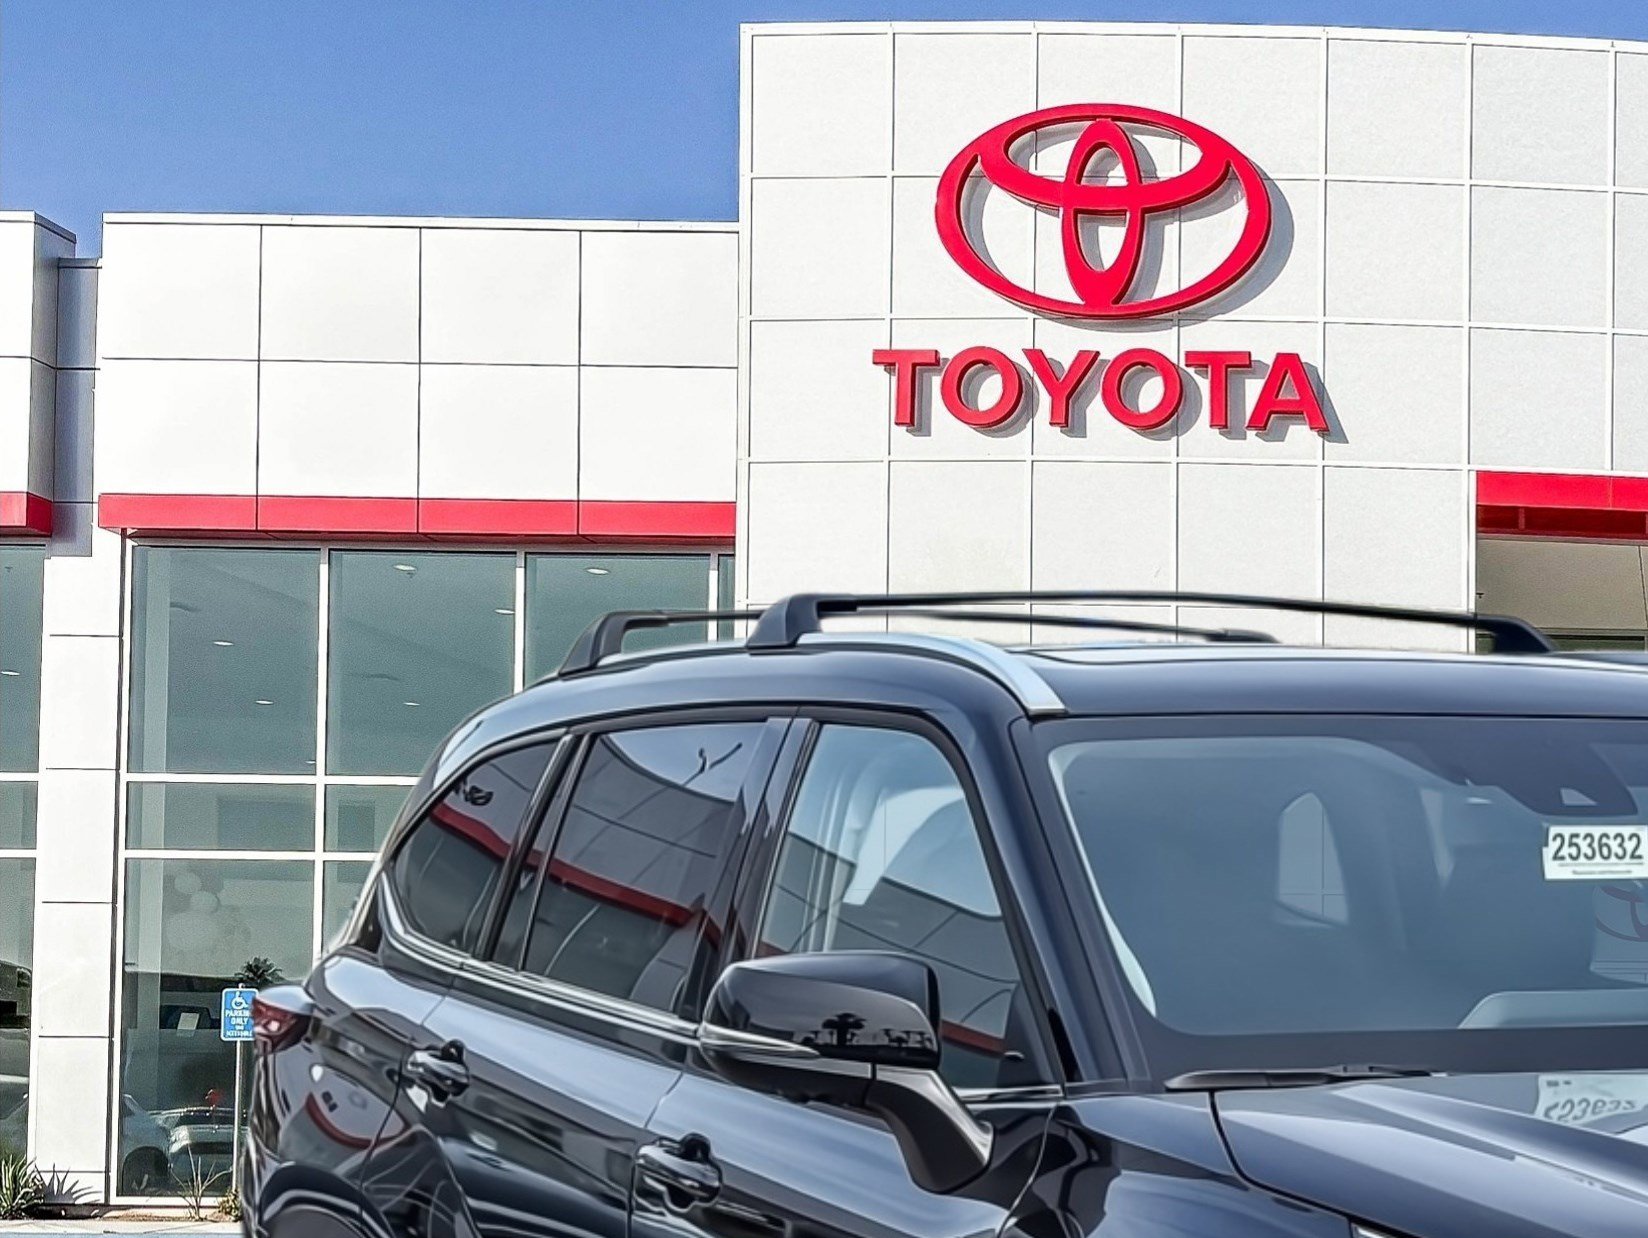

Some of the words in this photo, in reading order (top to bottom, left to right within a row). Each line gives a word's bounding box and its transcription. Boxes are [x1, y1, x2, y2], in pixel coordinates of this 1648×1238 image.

[872, 345, 1330, 434] TOYOTA
[1551, 832, 1644, 861] 253632
[225, 1009, 250, 1017] PARKIN
